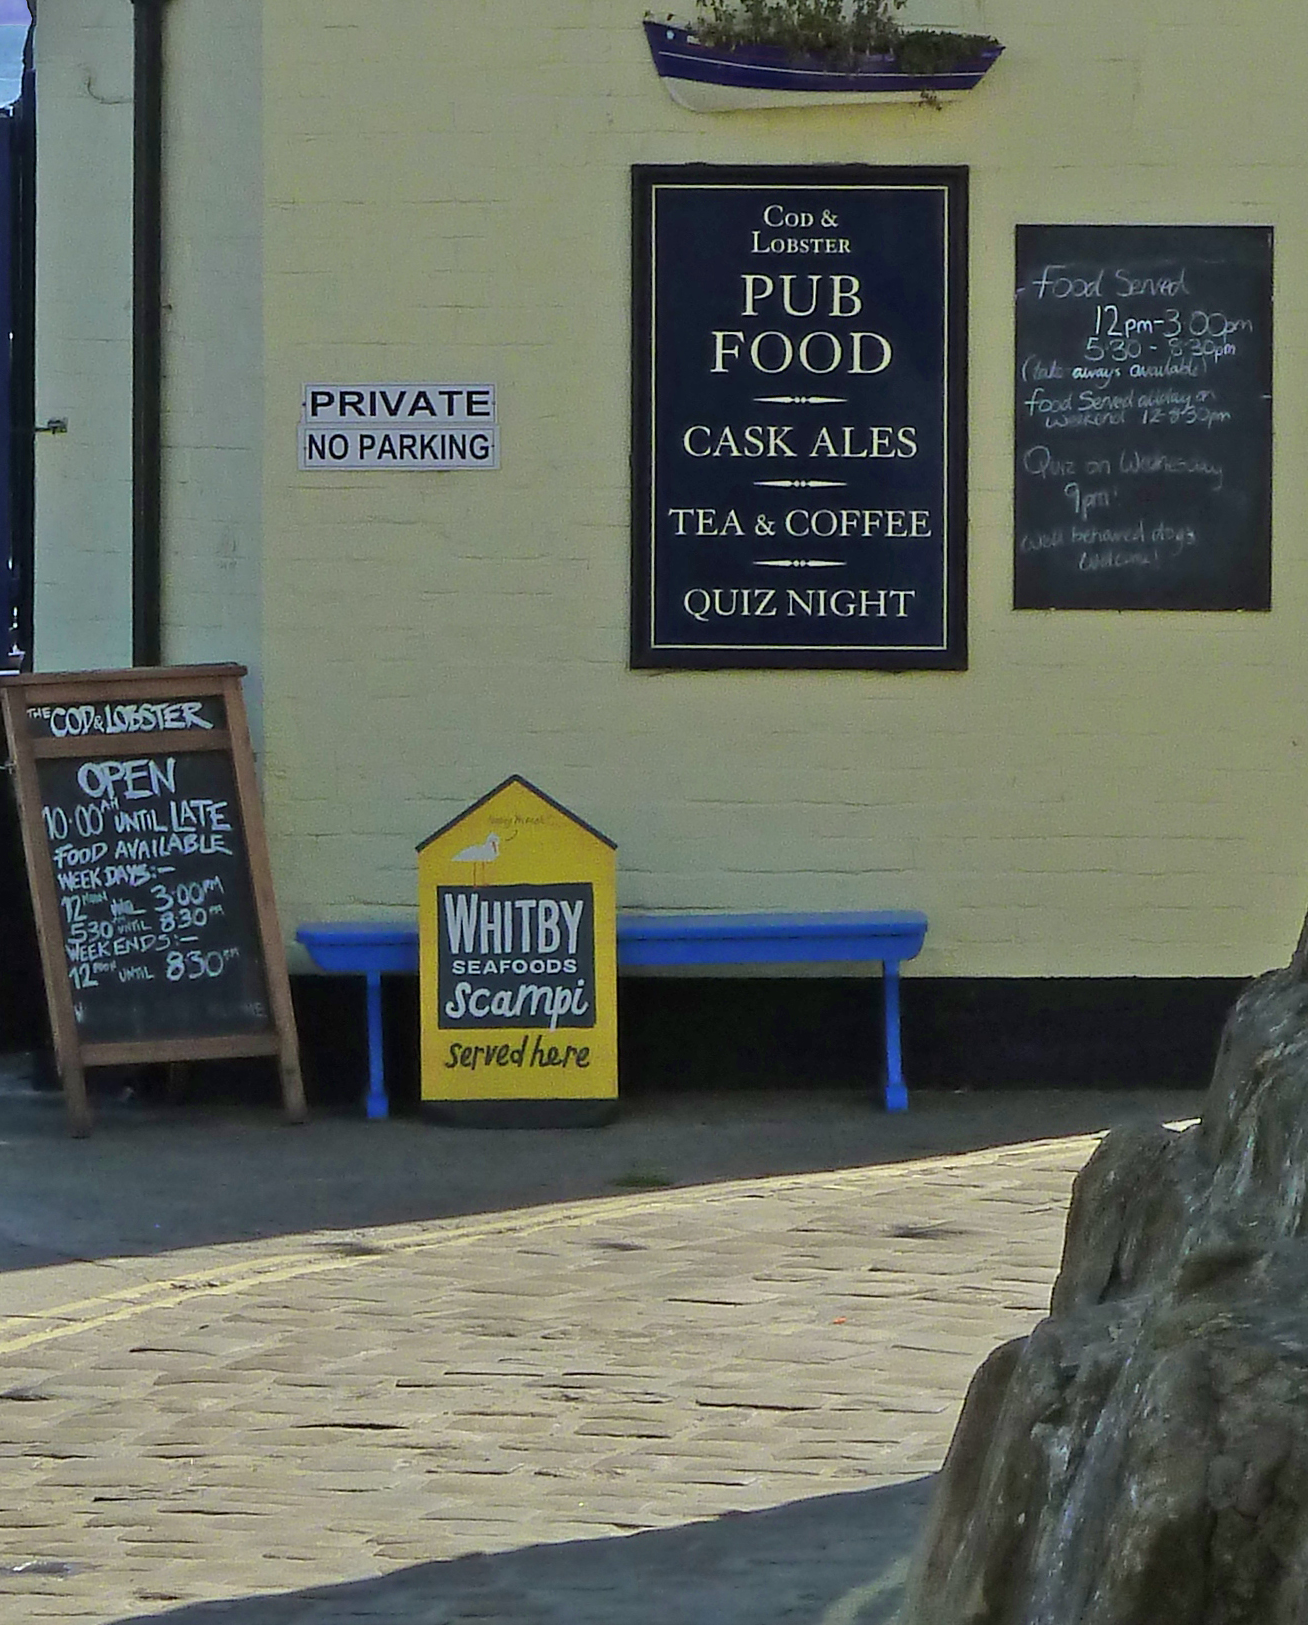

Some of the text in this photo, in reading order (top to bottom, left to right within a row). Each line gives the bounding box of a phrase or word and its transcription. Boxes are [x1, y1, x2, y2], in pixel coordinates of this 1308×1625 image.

[763, 205, 839, 228] COD &
[751, 231, 851, 254] LOBSTER
[741, 275, 863, 317] PUB
[1033, 265, 1189, 299] Food Served
[710, 331, 892, 374] FOOD
[311, 391, 490, 416] PRIVATE
[308, 434, 489, 460] NO PARKING
[683, 425, 917, 459] CASK ALES
[1024, 445, 1075, 479] Quiz
[1087, 460, 1110, 474] on
[669, 508, 931, 537] TEA & COFFEE
[684, 589, 916, 620] QUIZ NIGHT
[27, 707, 50, 719] THE
[77, 757, 176, 799] OPEN
[115, 809, 168, 832] UNTIL
[170, 799, 232, 833] LATE
[54, 833, 233, 869] FOOD AVAILABLE
[117, 921, 152, 934] UNTIL
[444, 893, 584, 955] WHITBY
[119, 966, 154, 982] UNTIL
[452, 959, 577, 975] SEAFOODS
[445, 979, 589, 1031] Scampi
[445, 1035, 590, 1070] served here
